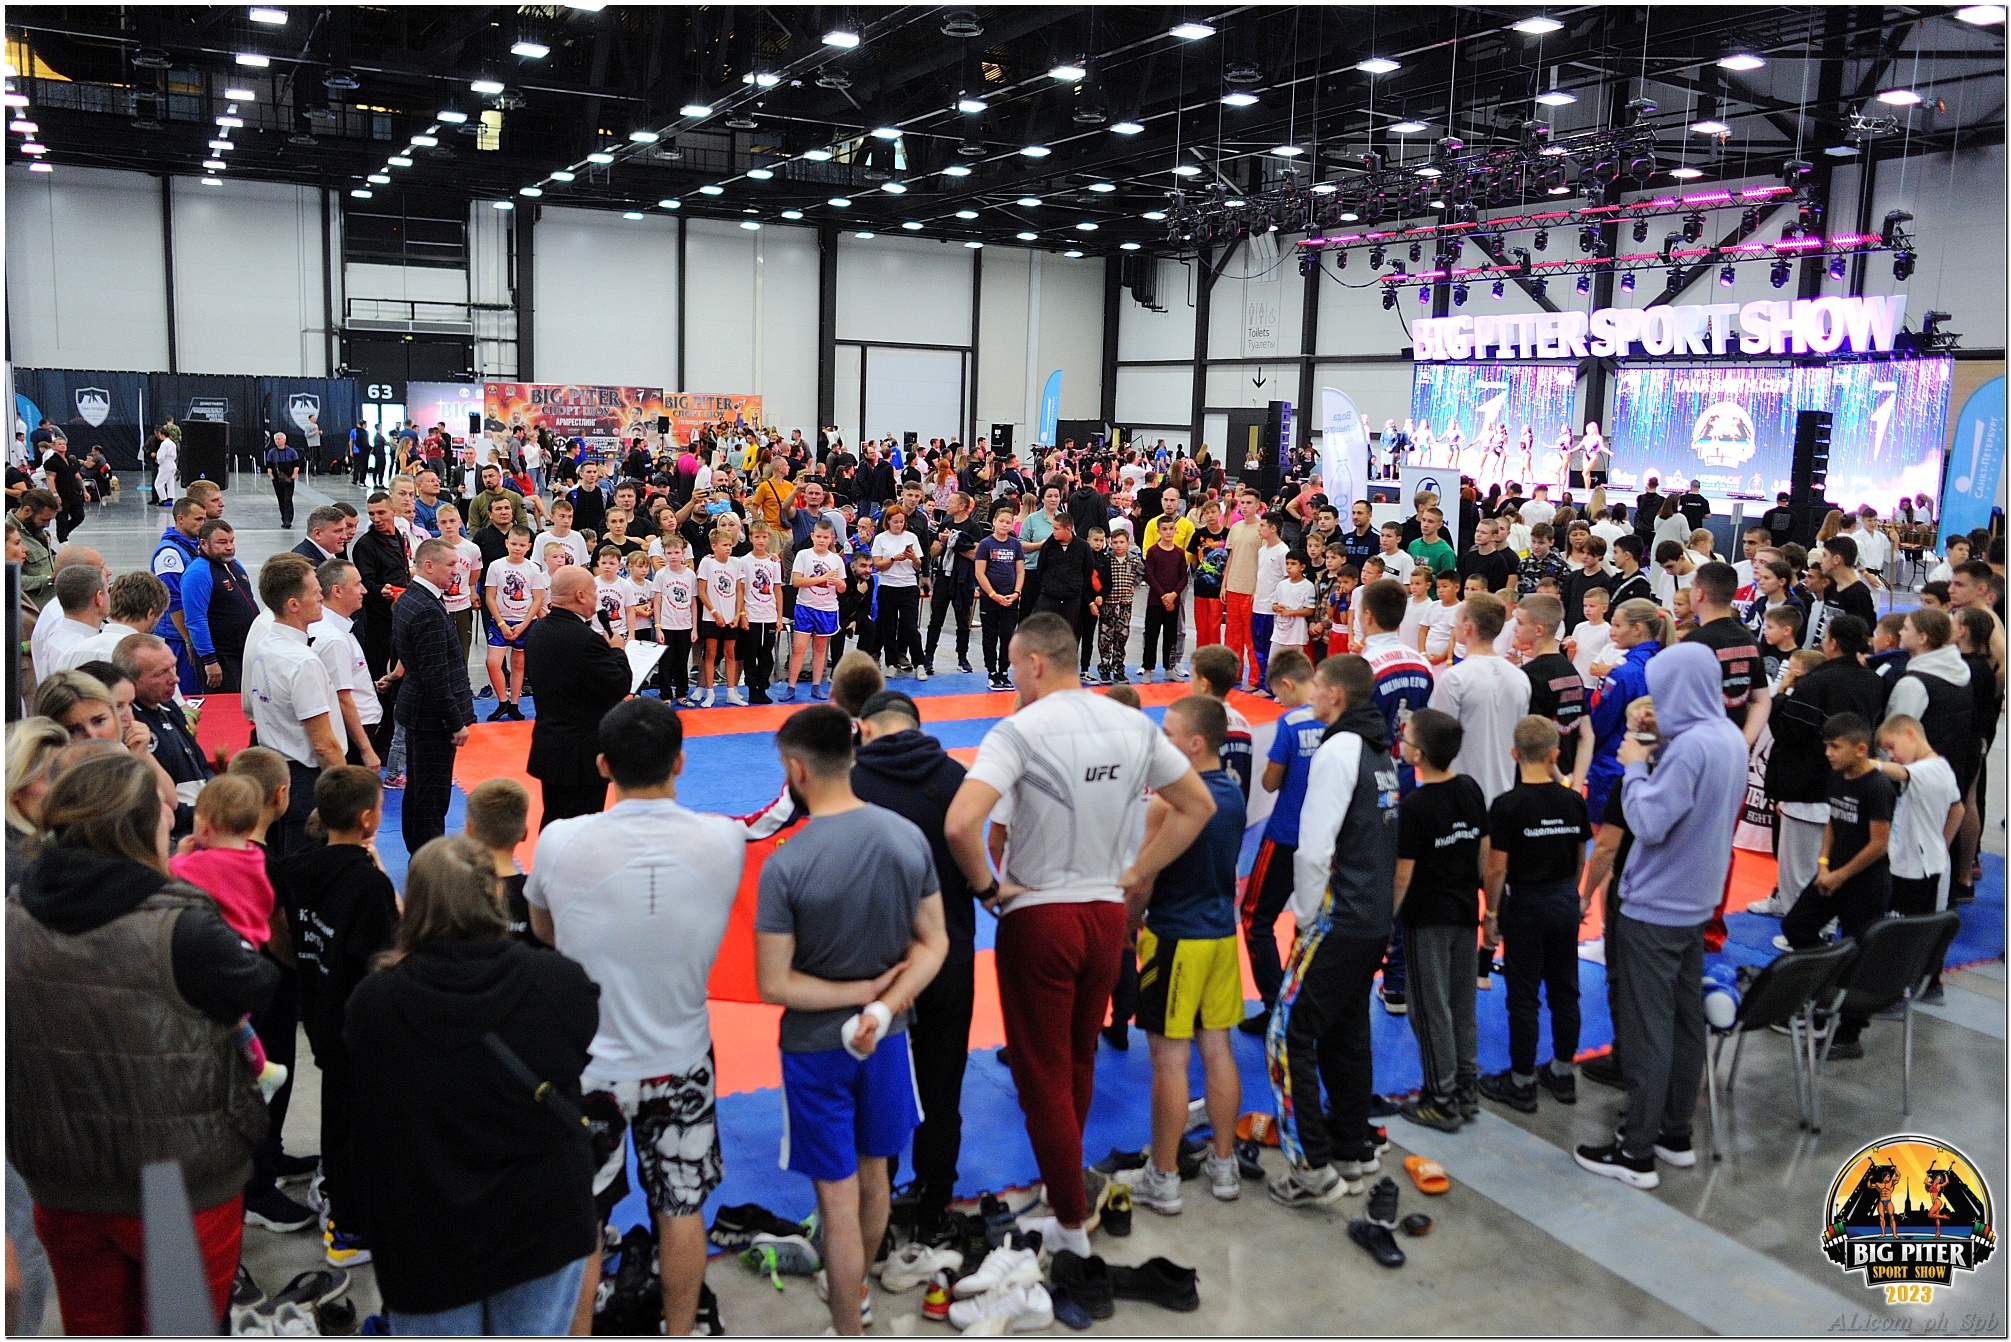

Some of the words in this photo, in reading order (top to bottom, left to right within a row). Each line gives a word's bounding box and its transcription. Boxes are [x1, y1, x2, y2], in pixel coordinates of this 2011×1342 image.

[1248, 327, 1270, 338] Toilets
[1412, 315, 1475, 360] BIG
[1474, 311, 1589, 359] PITER
[1590, 303, 1739, 357] SPORT
[1740, 294, 1907, 354] SHOW
[1247, 339, 1276, 351] Туалеты
[367, 384, 393, 399] 63
[530, 388, 563, 405] BIG
[568, 388, 622, 407] PITER
[664, 396, 689, 409] BIG
[693, 396, 733, 410] PITER
[542, 406, 579, 416] СПОРТ
[582, 406, 611, 416] ШОУ
[555, 418, 596, 426] АРМРЕСТЛИНГ
[1974, 416, 1999, 499] САНКТ-ПЕТЕРБУРГ
[1084, 764, 1121, 782] UFC
